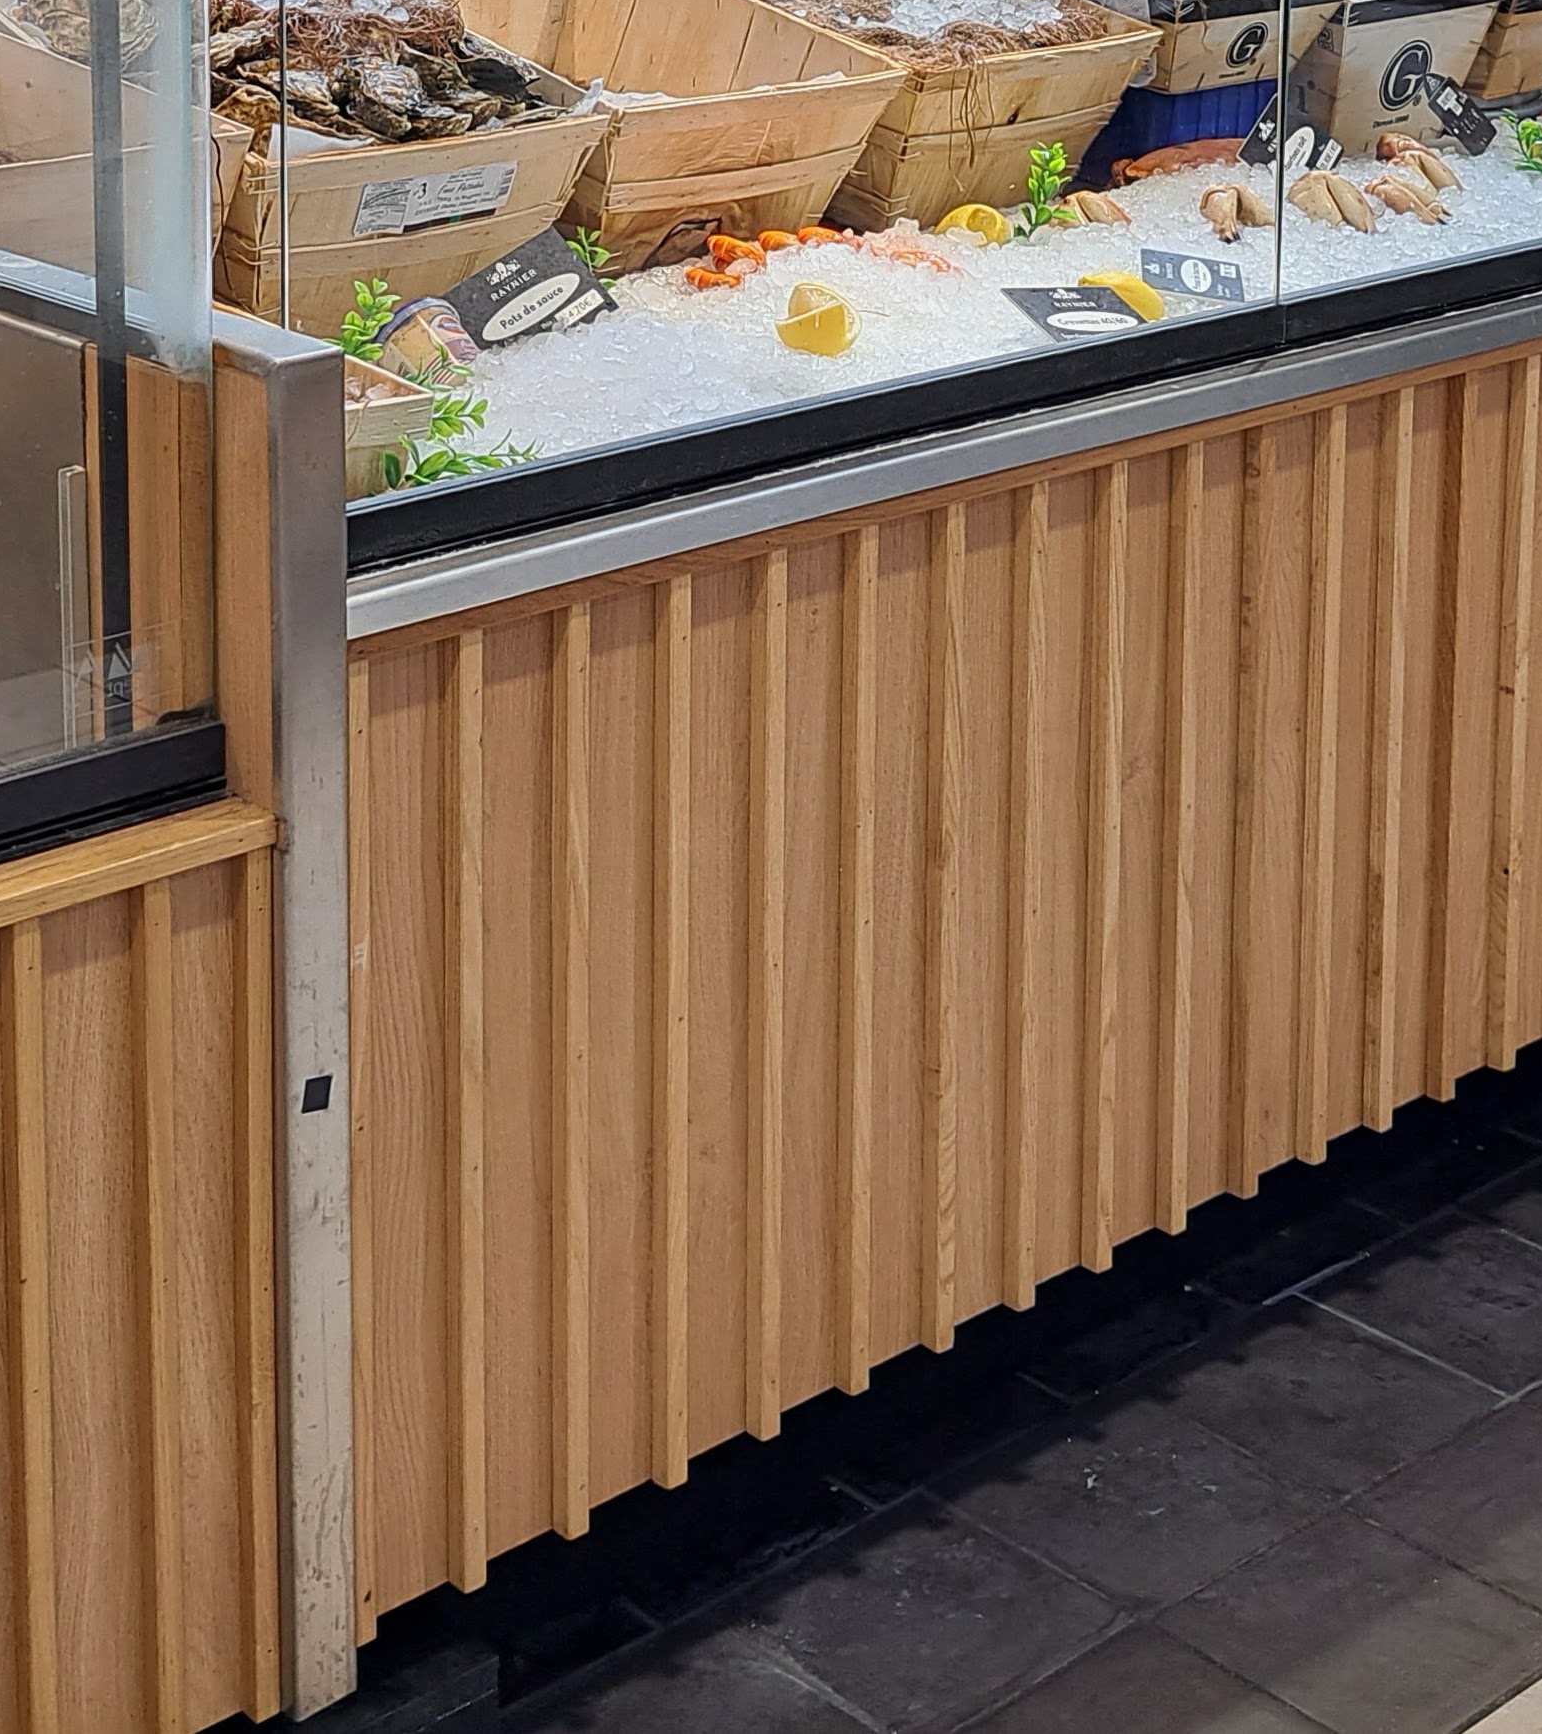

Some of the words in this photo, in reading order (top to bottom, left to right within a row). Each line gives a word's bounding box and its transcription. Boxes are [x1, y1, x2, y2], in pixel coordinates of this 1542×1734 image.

[489, 268, 539, 303] RAYNIER
[499, 311, 523, 331] Pots
[522, 303, 538, 317] de
[536, 286, 565, 307] sauce
